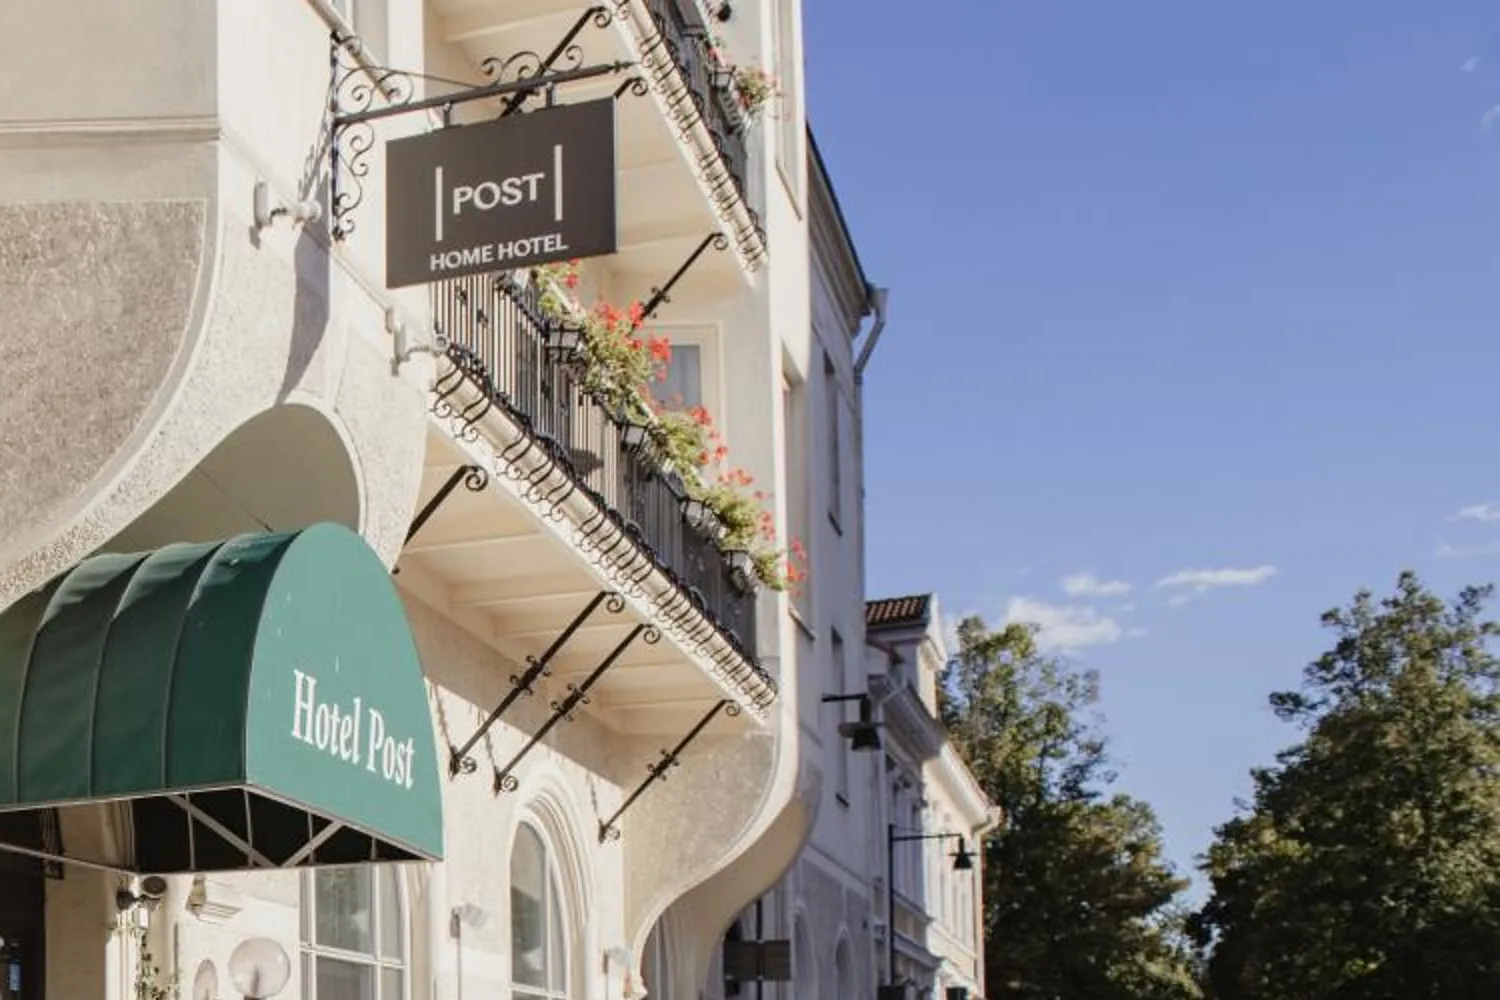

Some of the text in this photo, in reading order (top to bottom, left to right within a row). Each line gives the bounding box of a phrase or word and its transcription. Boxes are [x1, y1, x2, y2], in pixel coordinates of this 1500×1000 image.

[453, 172, 546, 215] POST
[429, 233, 569, 271] HOME HOTEL
[292, 669, 415, 790] Hotel Post
